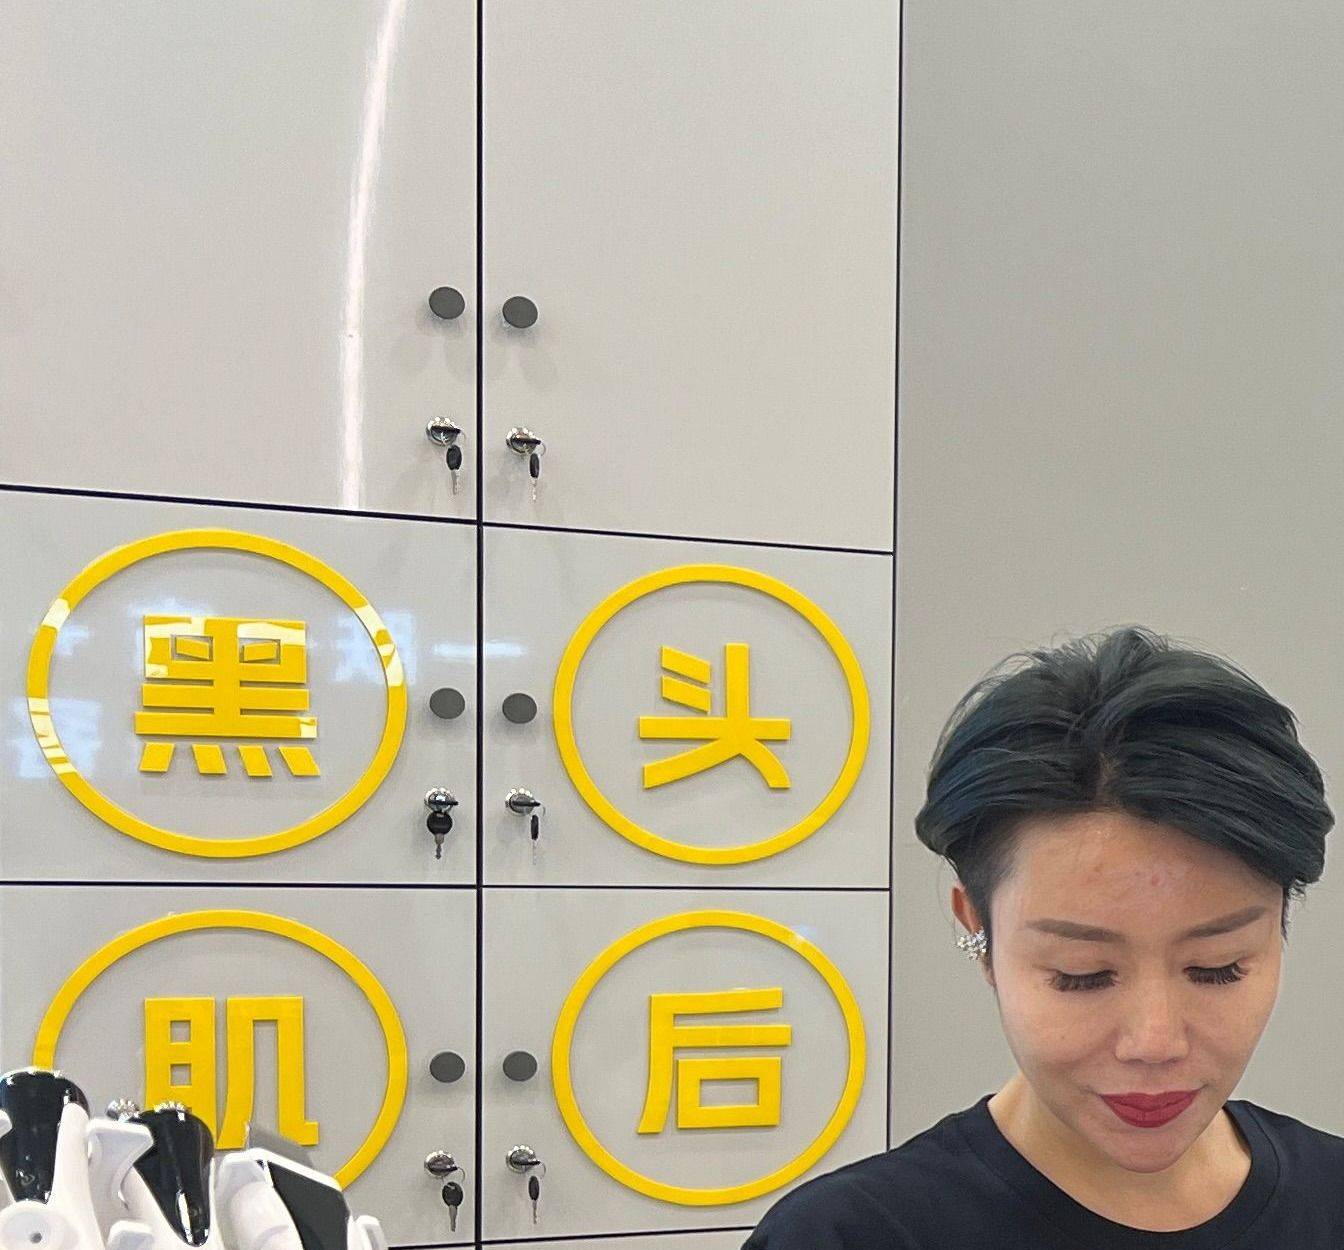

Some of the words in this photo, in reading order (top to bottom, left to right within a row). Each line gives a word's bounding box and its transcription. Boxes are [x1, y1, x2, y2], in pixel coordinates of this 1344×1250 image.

[134, 615, 321, 777] 黑
[638, 643, 792, 790] 头
[144, 997, 320, 1150] 肌
[637, 988, 792, 1135] 后
